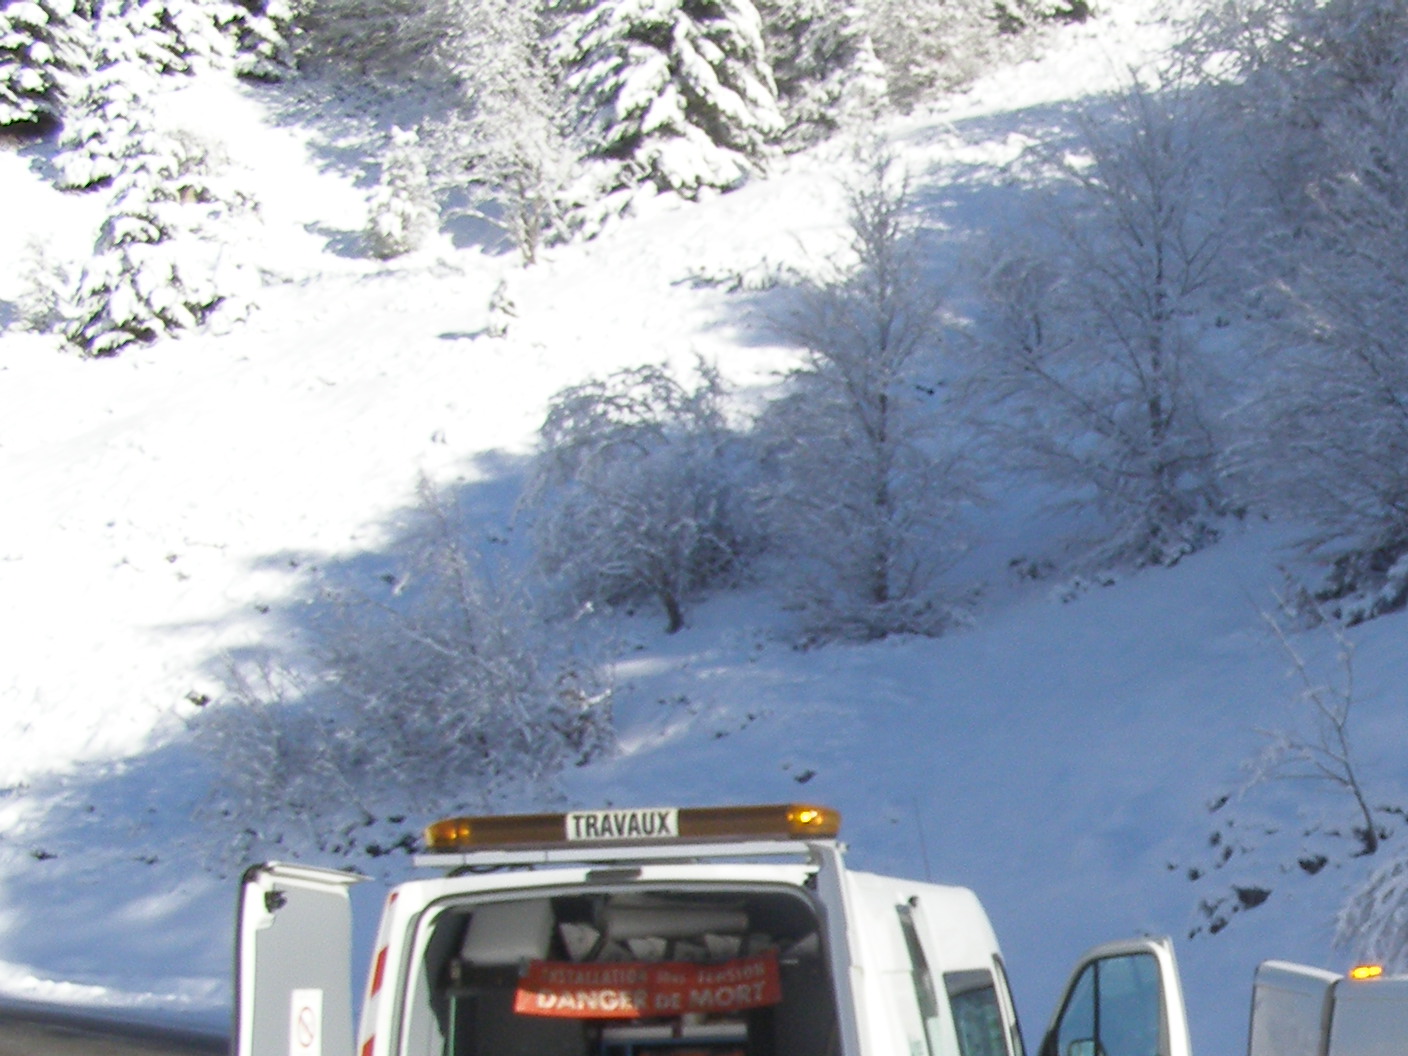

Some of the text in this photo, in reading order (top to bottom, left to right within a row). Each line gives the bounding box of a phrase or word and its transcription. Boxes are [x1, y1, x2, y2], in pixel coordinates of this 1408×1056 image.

[573, 811, 671, 837] TRAVAUX
[535, 980, 766, 1011] DANGER DE MORT
